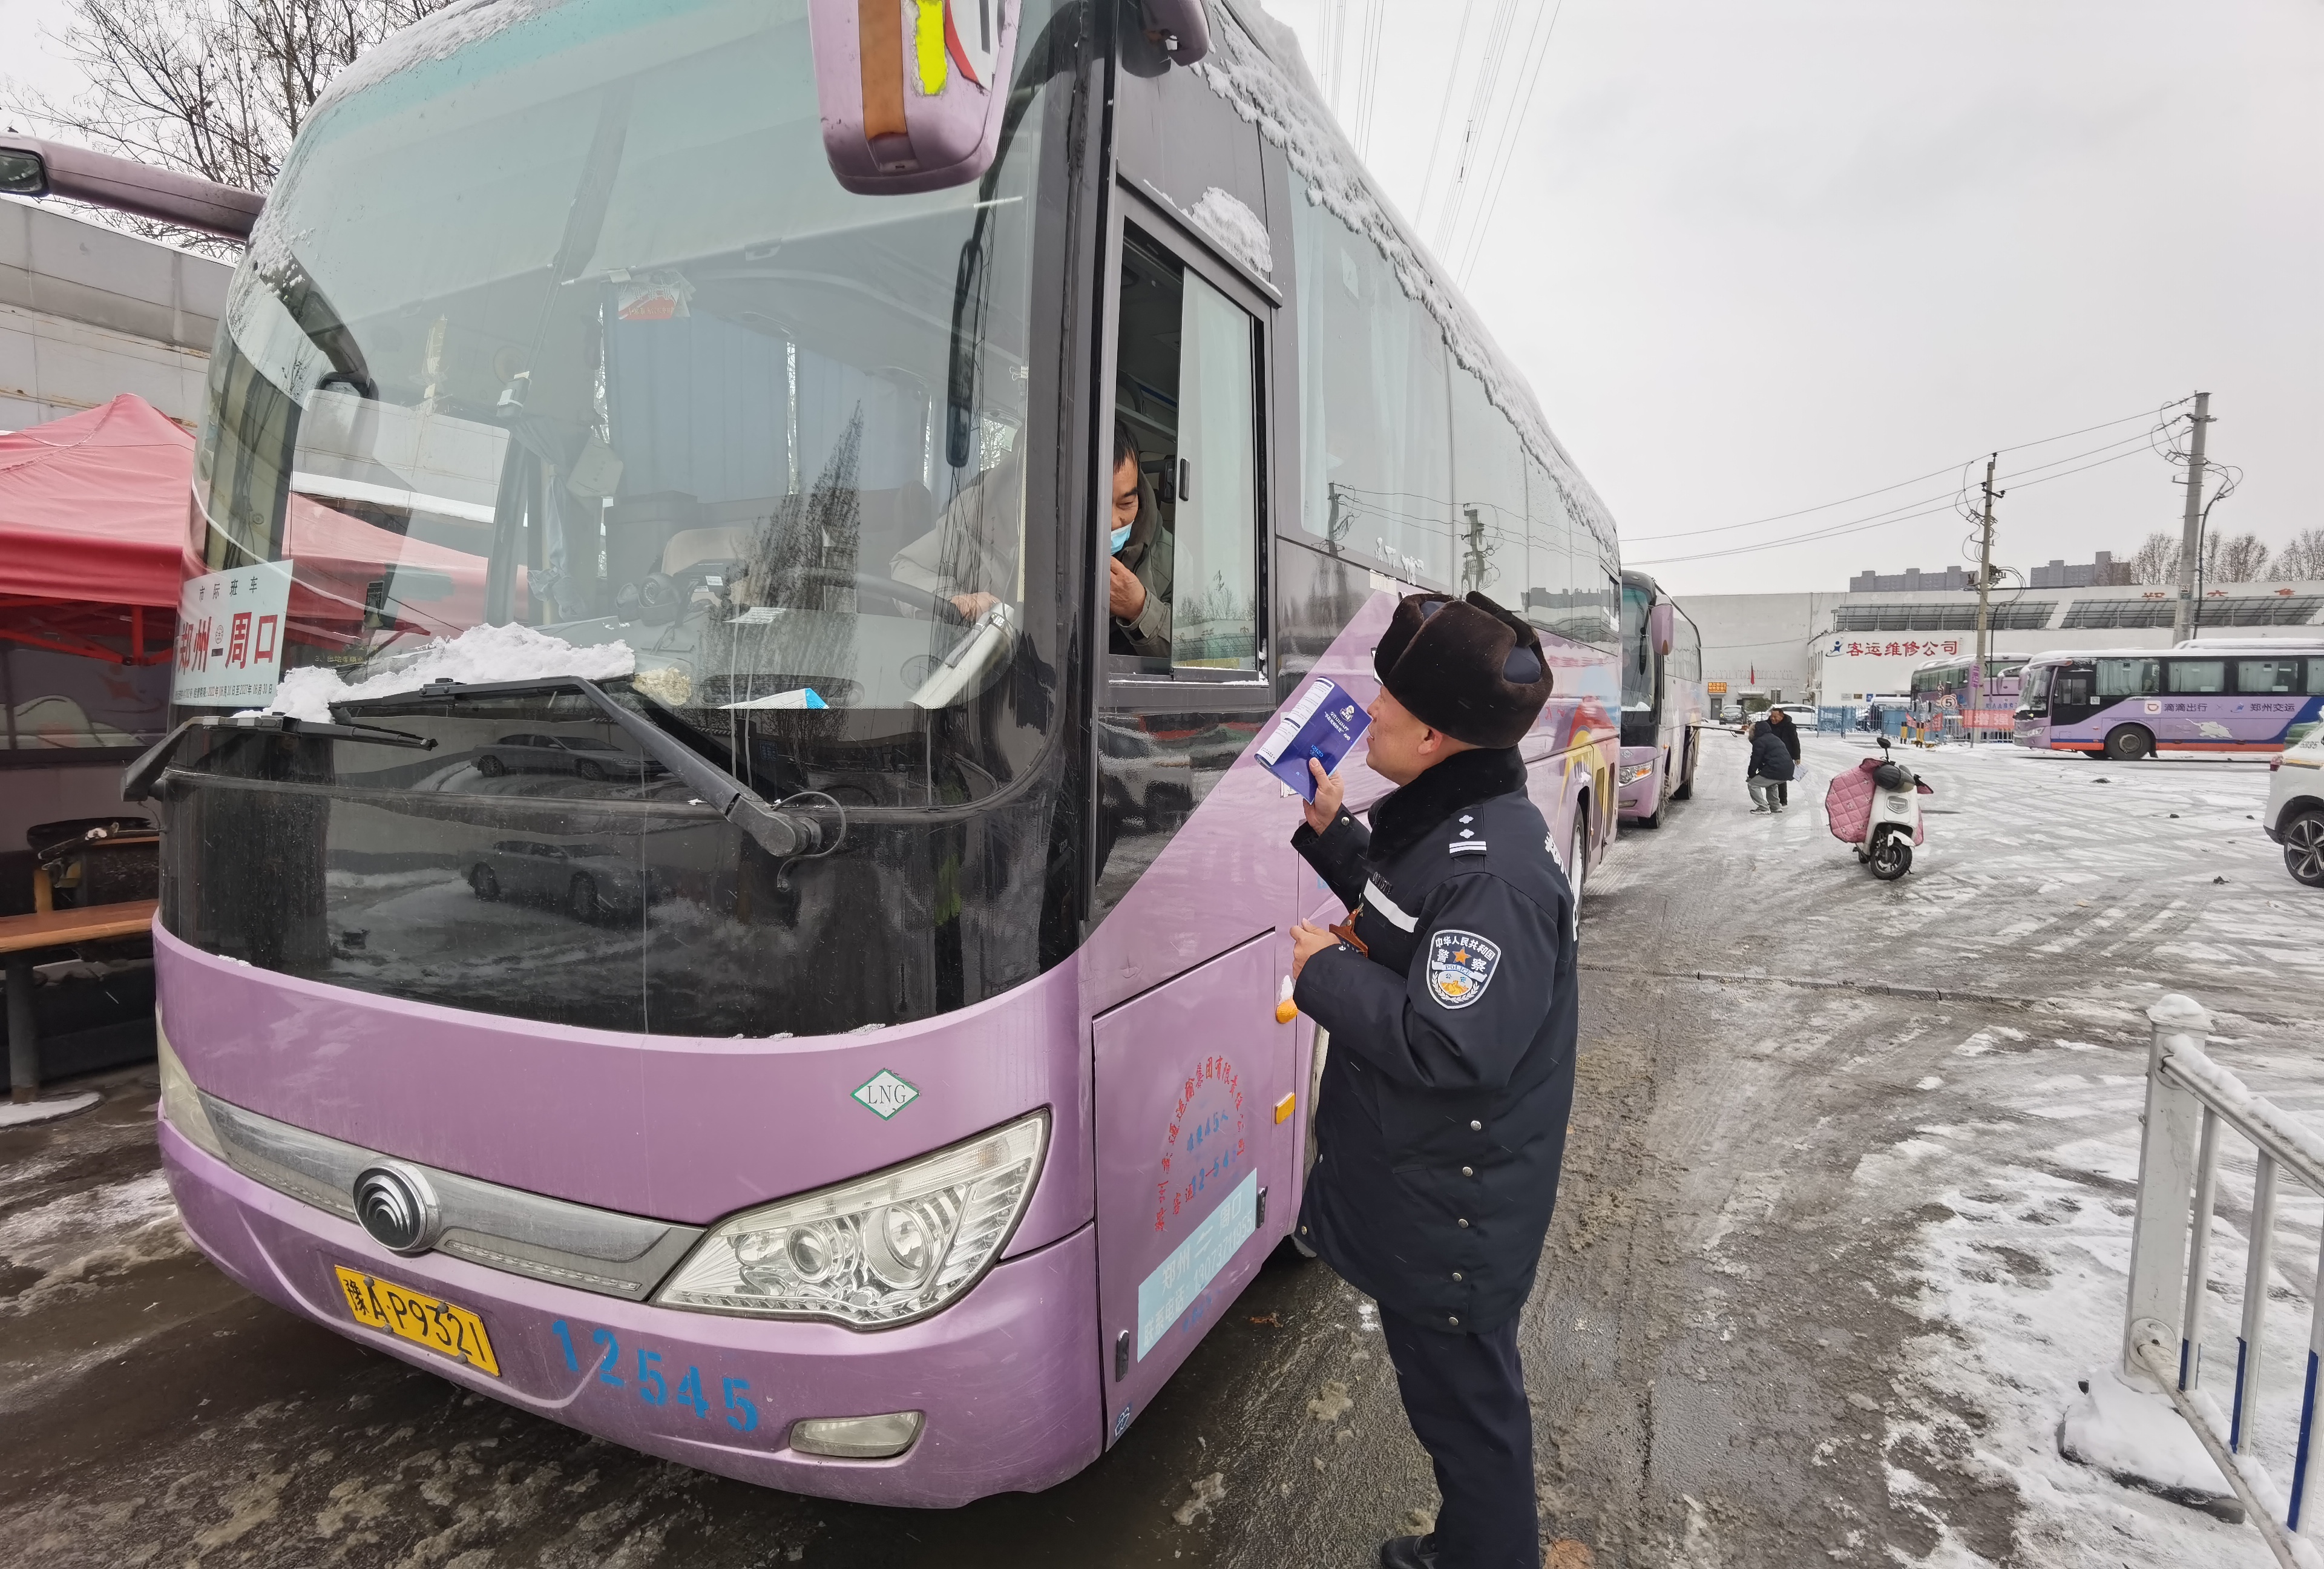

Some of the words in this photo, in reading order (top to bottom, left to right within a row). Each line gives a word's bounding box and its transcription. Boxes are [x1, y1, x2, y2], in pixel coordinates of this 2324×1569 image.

[199, 576, 258, 602] 市际班车
[1846, 640, 1958, 657] 客运维修公司
[1945, 698, 1953, 708] 5
[2164, 703, 2208, 712] 滴滴出行
[2250, 703, 2296, 712] 郑州交运
[1974, 712, 2009, 725] 增强
[1436, 936, 1496, 961] 中华人民共和国
[1445, 965, 1473, 976] POLICE
[867, 1084, 906, 1104] LNG
[553, 1320, 758, 1432] 12545
